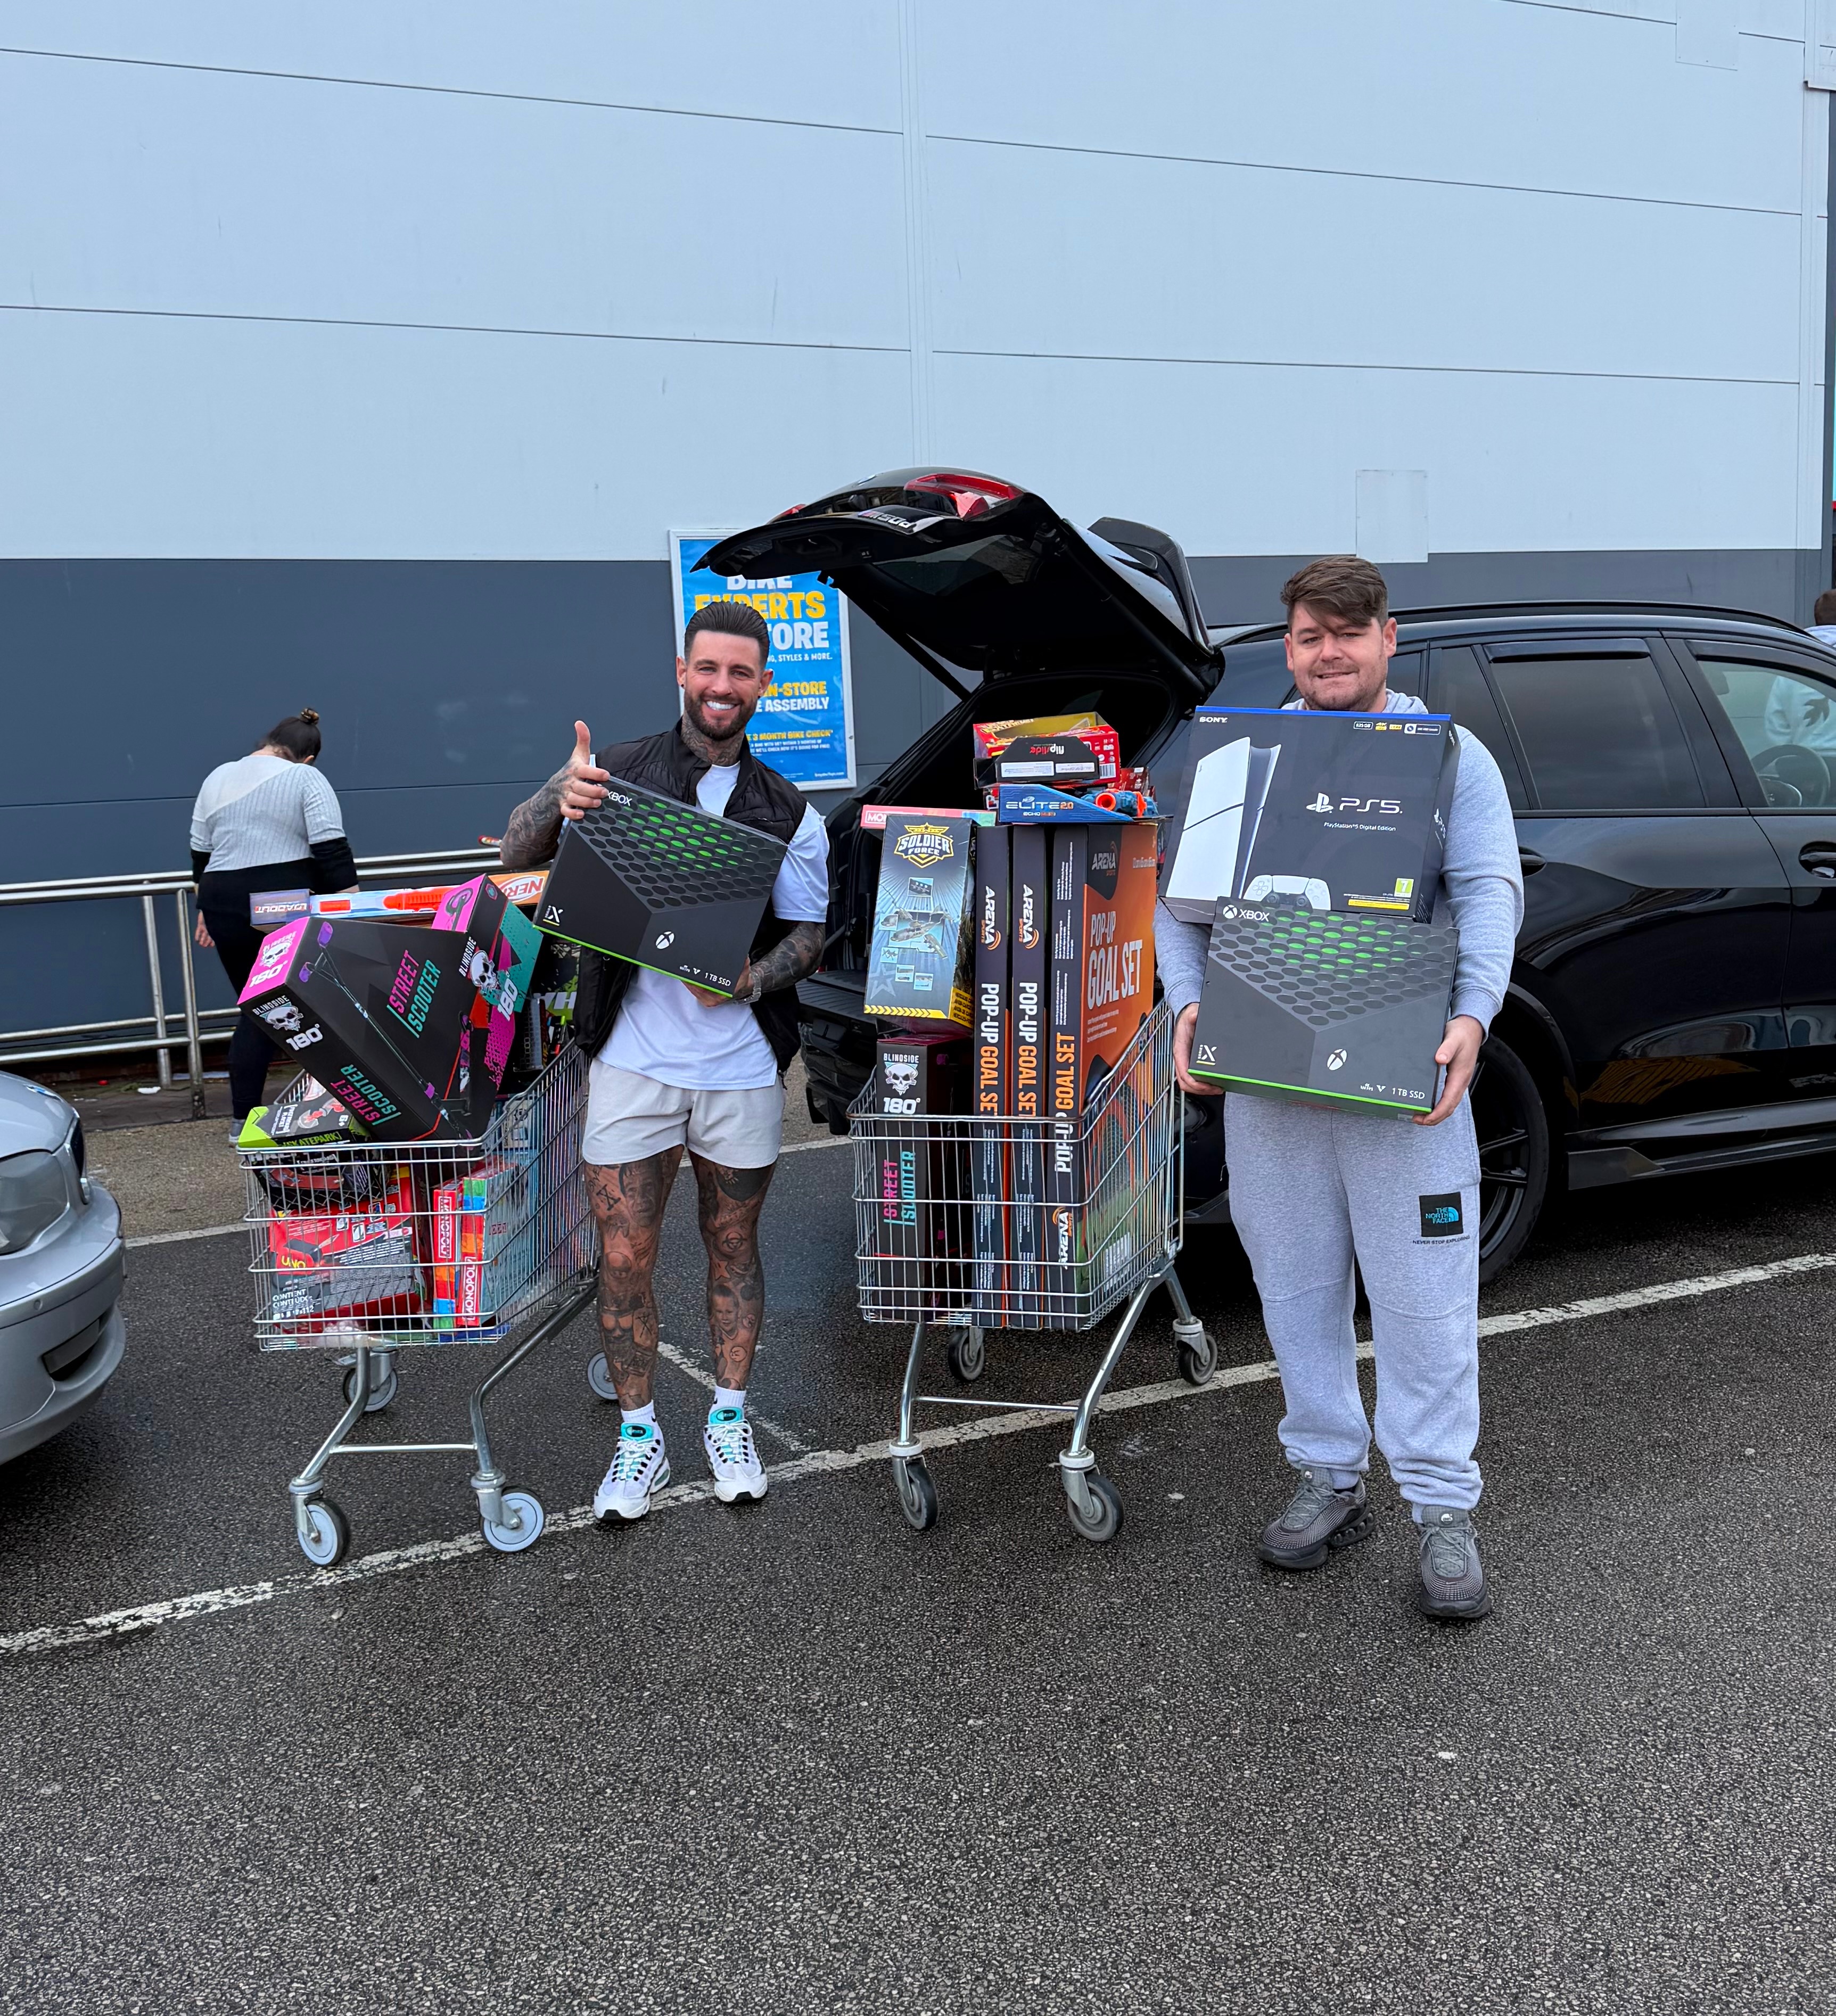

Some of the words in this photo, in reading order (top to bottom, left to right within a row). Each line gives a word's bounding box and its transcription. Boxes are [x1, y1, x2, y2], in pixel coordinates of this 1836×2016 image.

[695, 591, 826, 619] EERTS
[765, 697, 829, 712] ASSEMBLY
[867, 812, 887, 822] MO
[1006, 801, 1060, 809] ELITE
[899, 834, 950, 853] SOLDIER
[1091, 852, 1116, 870] ARENA
[985, 886, 995, 944] ARENA
[1023, 884, 1033, 944] ARENA
[1090, 911, 1116, 948] POP-UP
[1238, 909, 1270, 922] XBOX
[458, 936, 477, 977] BLINDSIDE
[390, 950, 419, 1014] STREET
[718, 977, 731, 986] SSD
[1088, 945, 1119, 1010] GOAL
[1121, 939, 1142, 999] SET
[252, 995, 290, 1016] BLINDSIDE
[408, 959, 441, 1032] SCOOTER
[1019, 982, 1038, 1043] POP-UP
[981, 983, 999, 1043] POP-UP
[286, 1024, 323, 1051] 180°
[1056, 1032, 1075, 1063] SET
[883, 1053, 919, 1063] BLINDSIDE
[981, 1046, 998, 1089] GOAL
[1018, 1045, 1037, 1089] GOAL
[330, 1080, 381, 1121] STREET
[340, 1064, 397, 1114] SCOOTER
[1056, 1066, 1074, 1110] GOAL
[1397, 1088, 1407, 1097] TB
[1409, 1091, 1425, 1099] SSD
[884, 1159, 898, 1218] STREET
[281, 1255, 306, 1269] UNO
[273, 1288, 307, 1302] CONTENT
